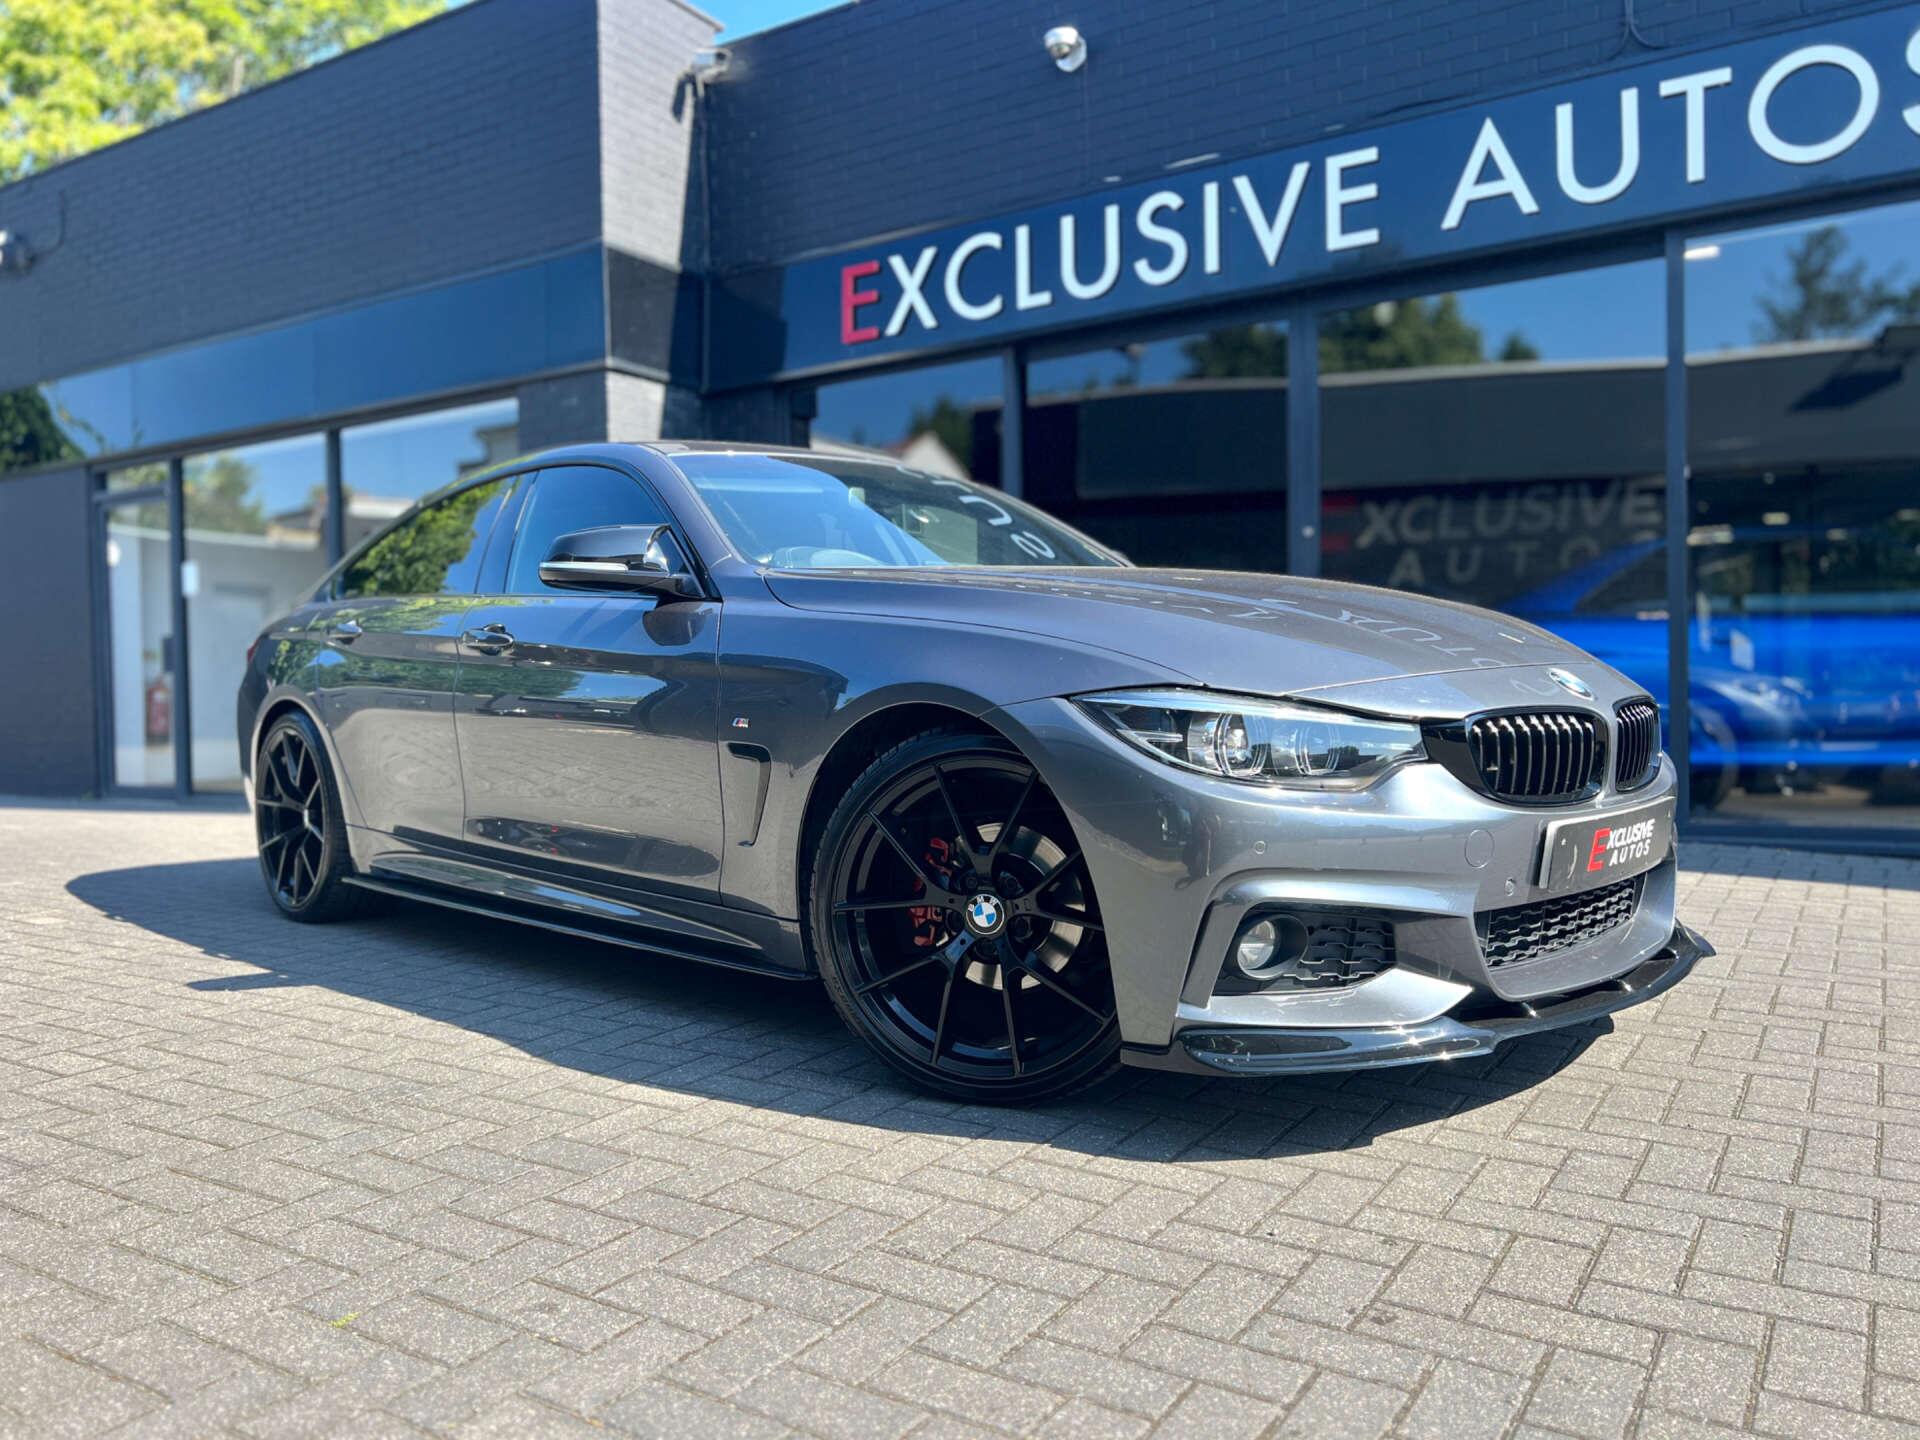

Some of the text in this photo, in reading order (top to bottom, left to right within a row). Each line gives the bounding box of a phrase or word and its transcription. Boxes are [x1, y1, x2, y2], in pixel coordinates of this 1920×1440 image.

[841, 28, 1920, 345] EXCLUSIVE AUTO
[1387, 531, 1656, 588] AUTO
[1587, 819, 1655, 872] EXCLUSIVE
[1608, 839, 1651, 867] AUTOS
